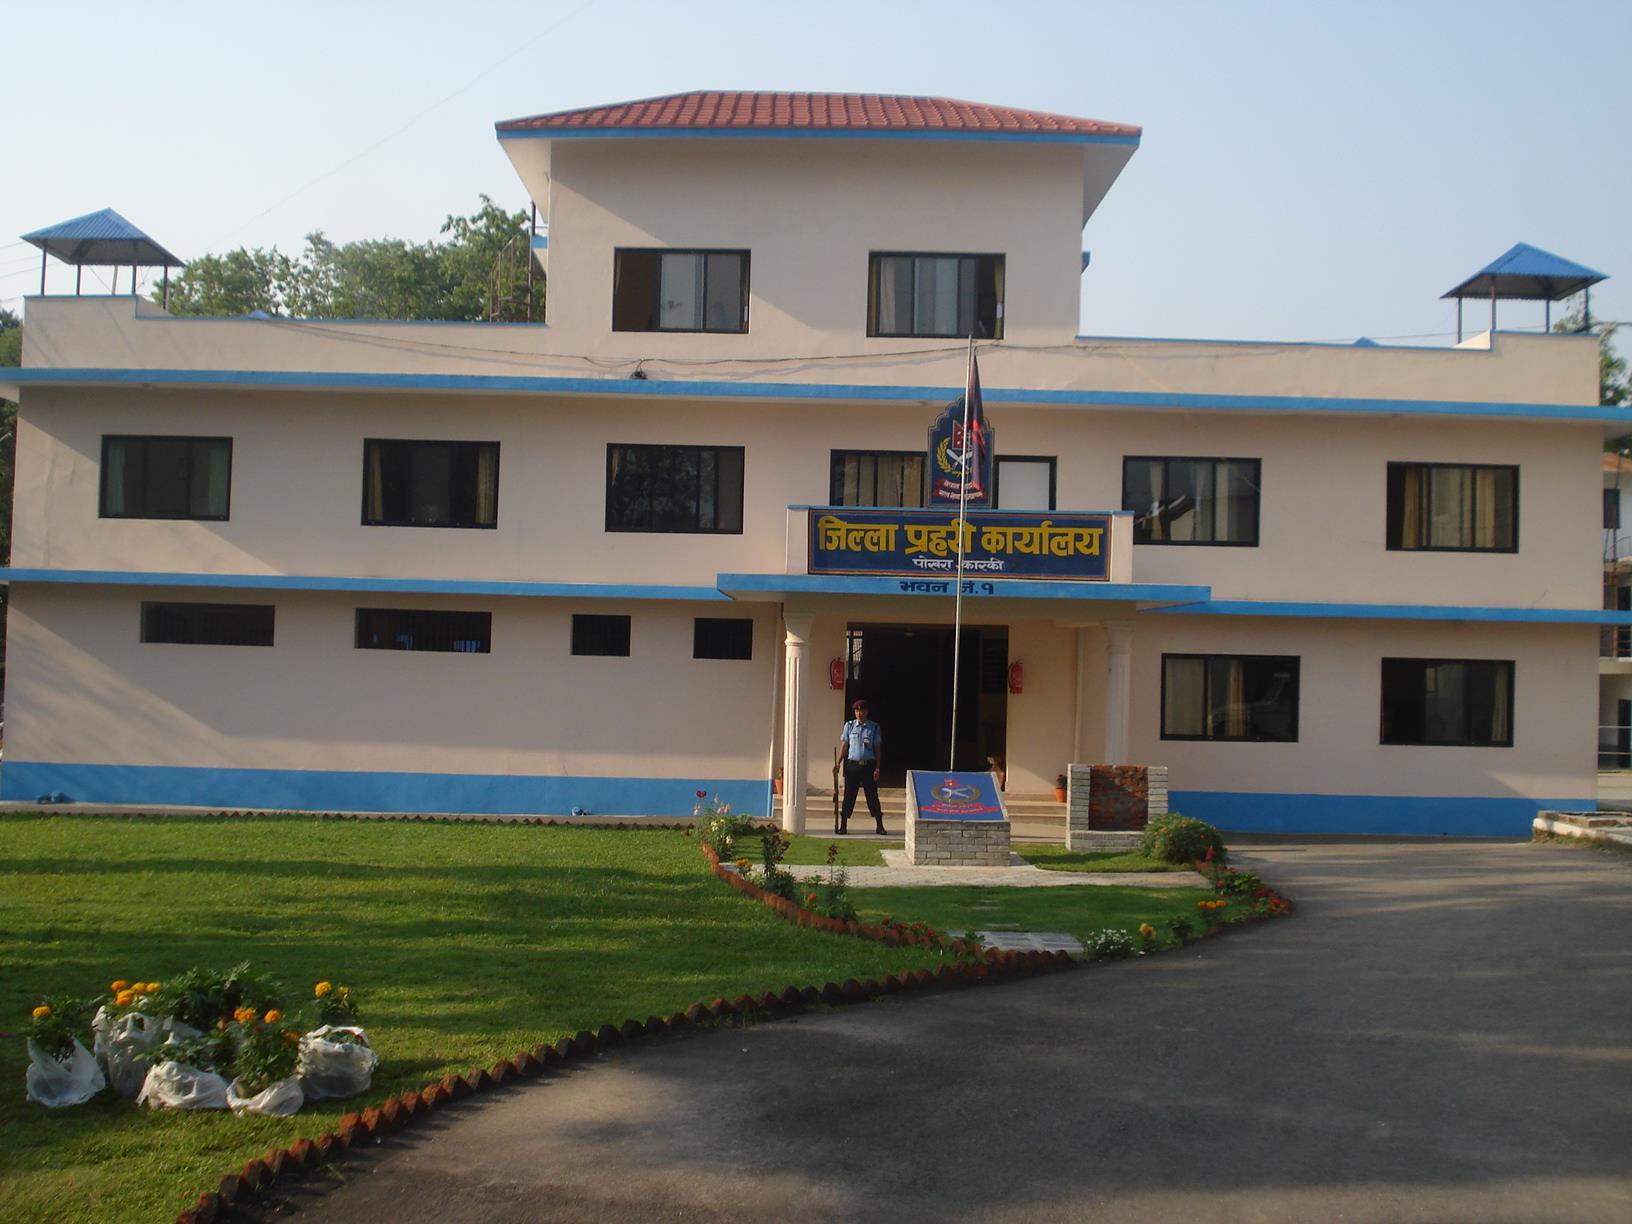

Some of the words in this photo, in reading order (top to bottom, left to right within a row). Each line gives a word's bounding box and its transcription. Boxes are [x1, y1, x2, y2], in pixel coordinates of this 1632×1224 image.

[817, 516, 899, 552] जिल्ला
[904, 518, 977, 556] प्रहरी
[981, 520, 1104, 557] कार्यालय
[899, 580, 949, 593] भवन
